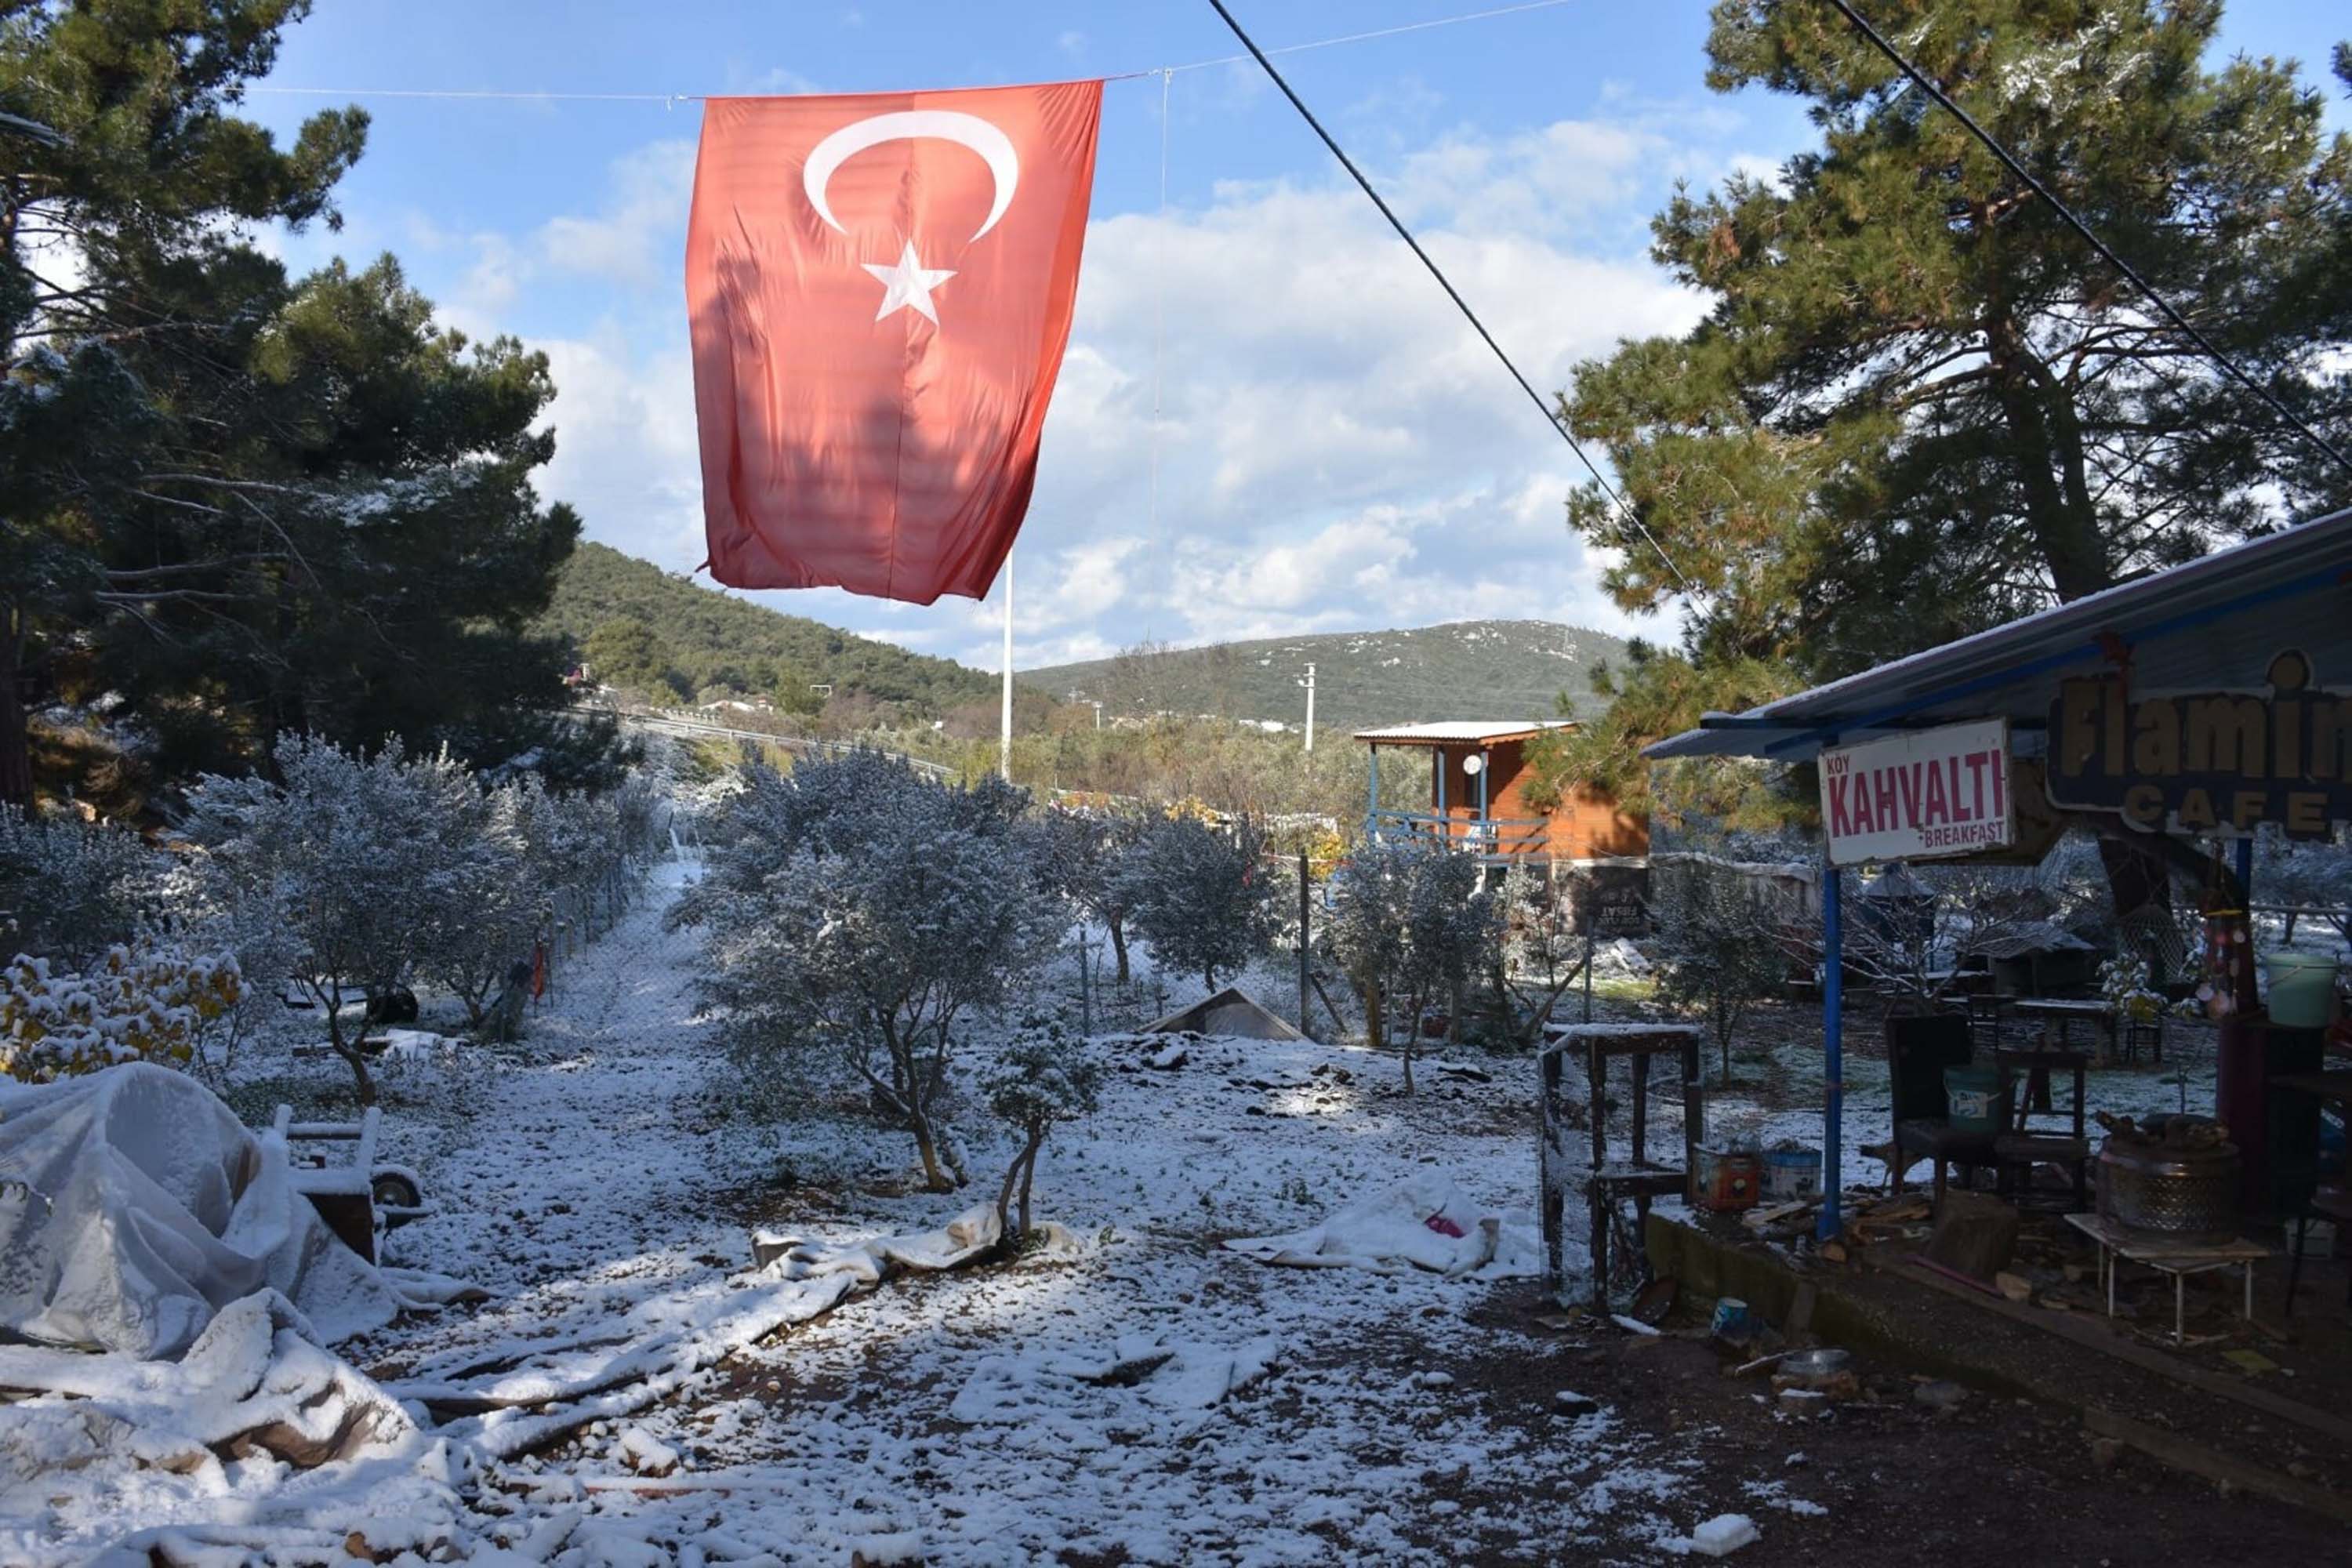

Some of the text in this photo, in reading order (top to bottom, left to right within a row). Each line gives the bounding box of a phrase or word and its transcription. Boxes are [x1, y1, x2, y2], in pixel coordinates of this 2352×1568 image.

[1828, 749, 2004, 838] KAHVALTI
[2125, 785, 2328, 832] CAFE
[1925, 821, 2004, 848] BREAKFAST
